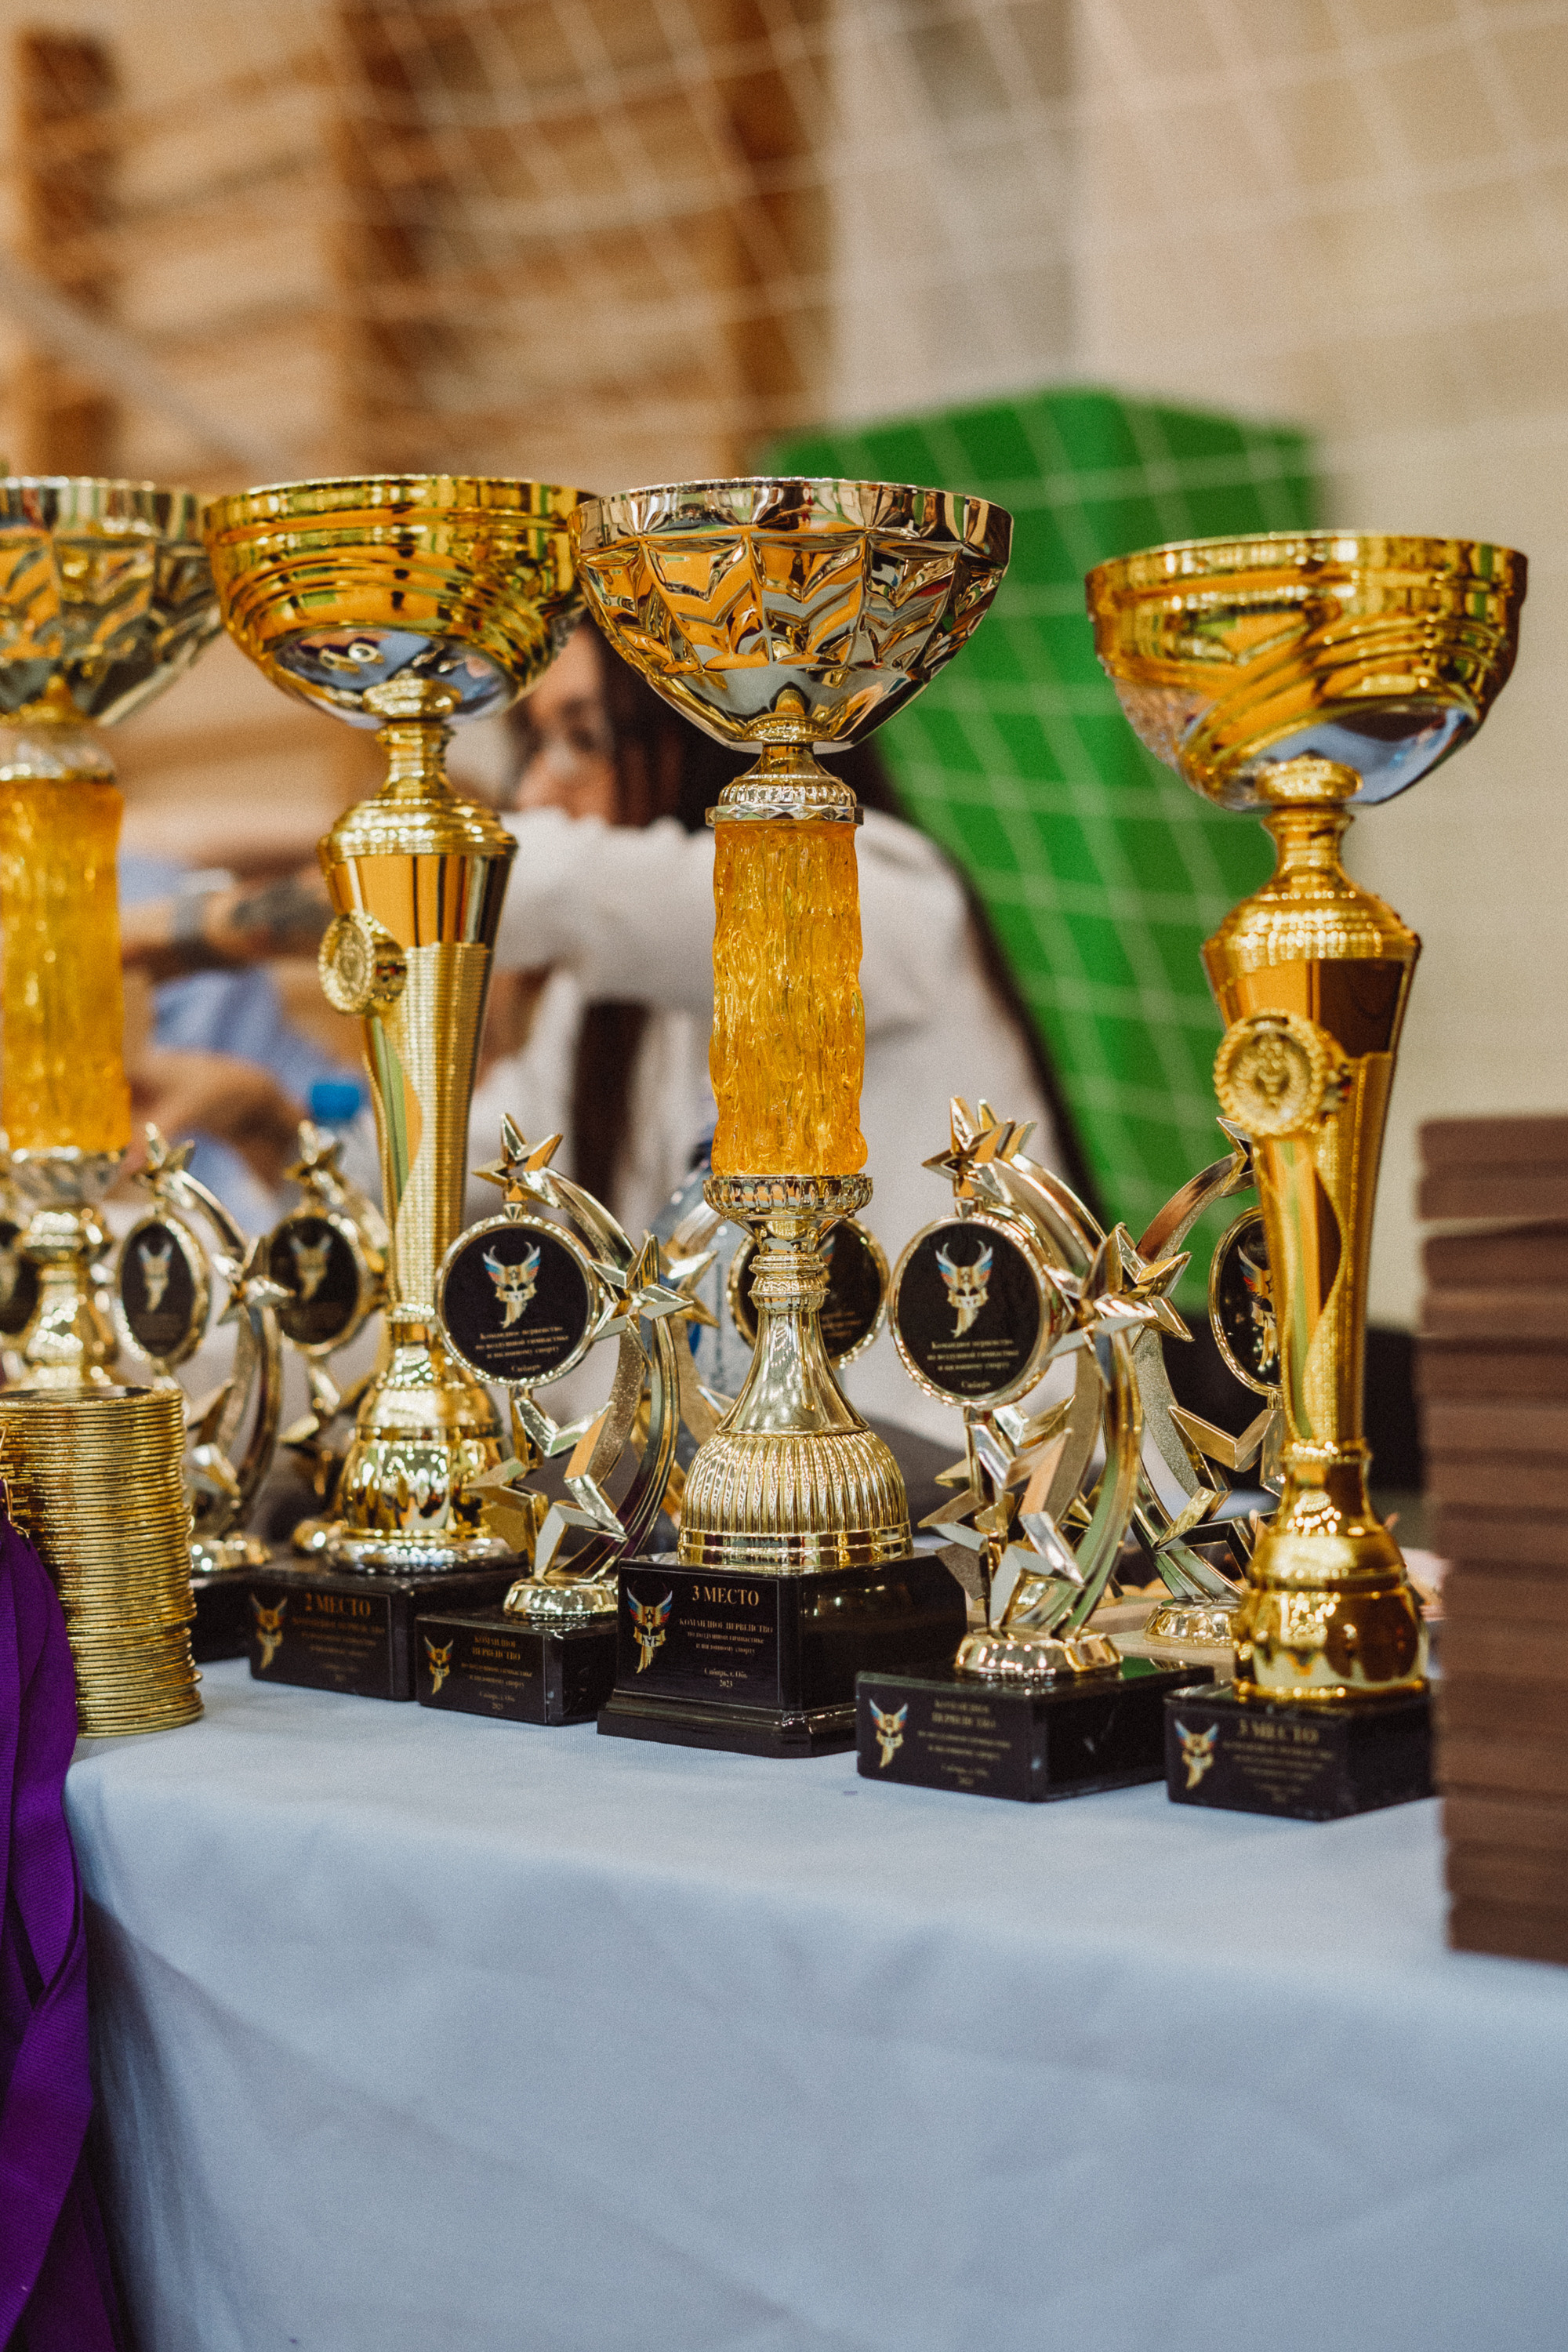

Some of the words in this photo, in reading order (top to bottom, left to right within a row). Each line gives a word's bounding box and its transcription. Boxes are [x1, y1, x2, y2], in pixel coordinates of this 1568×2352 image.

[316, 1594, 371, 1617] МЕСТО
[691, 1585, 699, 1602] 3
[704, 1586, 760, 1606] МЕСТО
[679, 1617, 723, 1628] КОМАНДНОЕ
[726, 1622, 774, 1633] ПЕРВЕНСТВО
